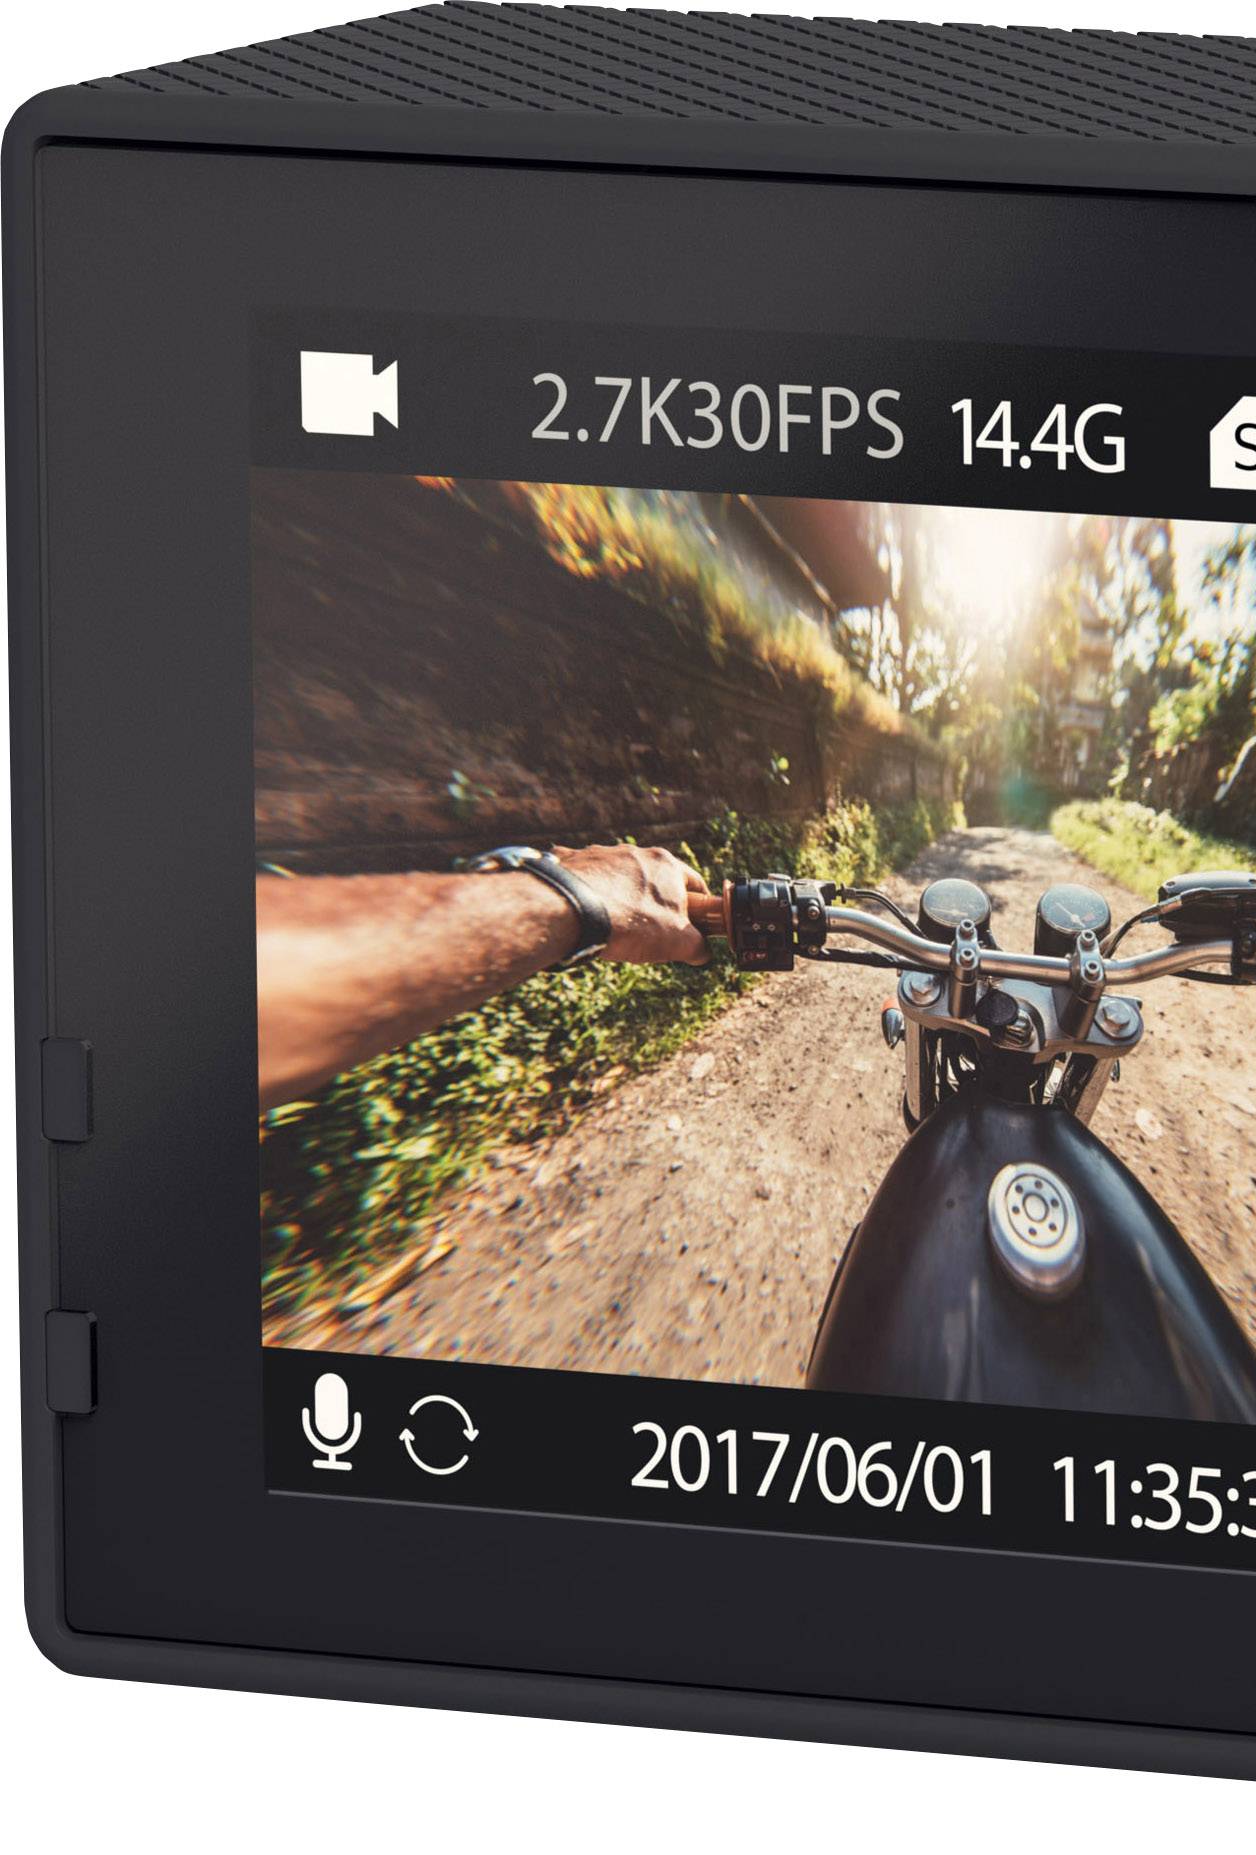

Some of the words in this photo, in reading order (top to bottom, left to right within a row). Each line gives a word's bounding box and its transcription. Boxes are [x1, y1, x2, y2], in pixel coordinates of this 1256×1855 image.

[532, 373, 903, 458] 2.7K30FPS
[952, 399, 1125, 473] 14.4G
[632, 1422, 991, 1515] 2017/06/01
